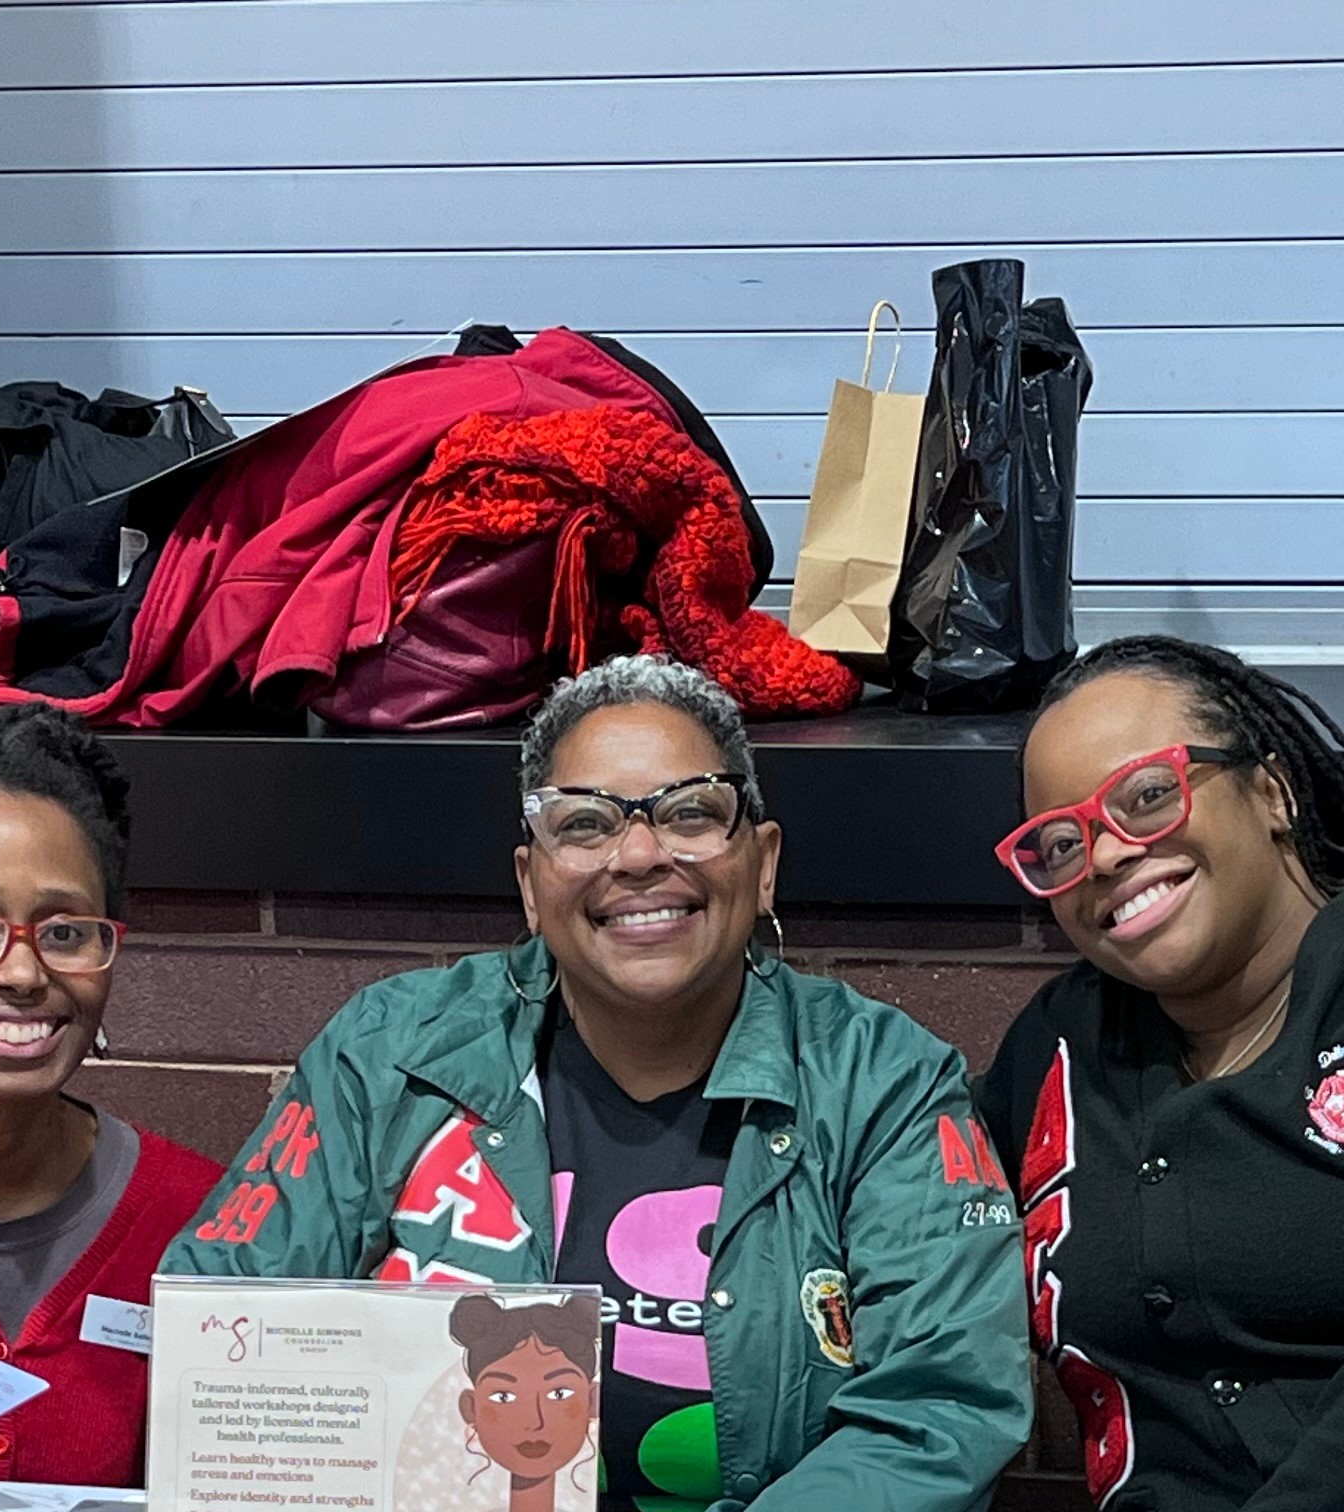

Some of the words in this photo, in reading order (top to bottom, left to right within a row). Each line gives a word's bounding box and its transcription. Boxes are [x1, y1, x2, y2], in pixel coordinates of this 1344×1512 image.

[311, 1385, 369, 1399] culturally
[192, 1399, 240, 1410] tailored
[242, 1400, 310, 1413] workshops
[313, 1402, 368, 1415] designed
[199, 1415, 222, 1425] and
[225, 1415, 243, 1426] led
[246, 1417, 262, 1429] by
[264, 1417, 314, 1428] licensed
[317, 1418, 360, 1429] mental
[217, 1430, 256, 1442] health
[192, 1452, 228, 1463] Learn
[230, 1453, 274, 1467] healthy
[279, 1456, 310, 1468] ways
[313, 1457, 324, 1467] to
[328, 1458, 378, 1470] manage
[191, 1471, 228, 1480] stress
[230, 1470, 253, 1481] and
[256, 1472, 314, 1482] emotions
[191, 1489, 238, 1502] Explore
[241, 1490, 287, 1505] identity
[290, 1492, 314, 1504] and
[316, 1494, 374, 1508] strengths
